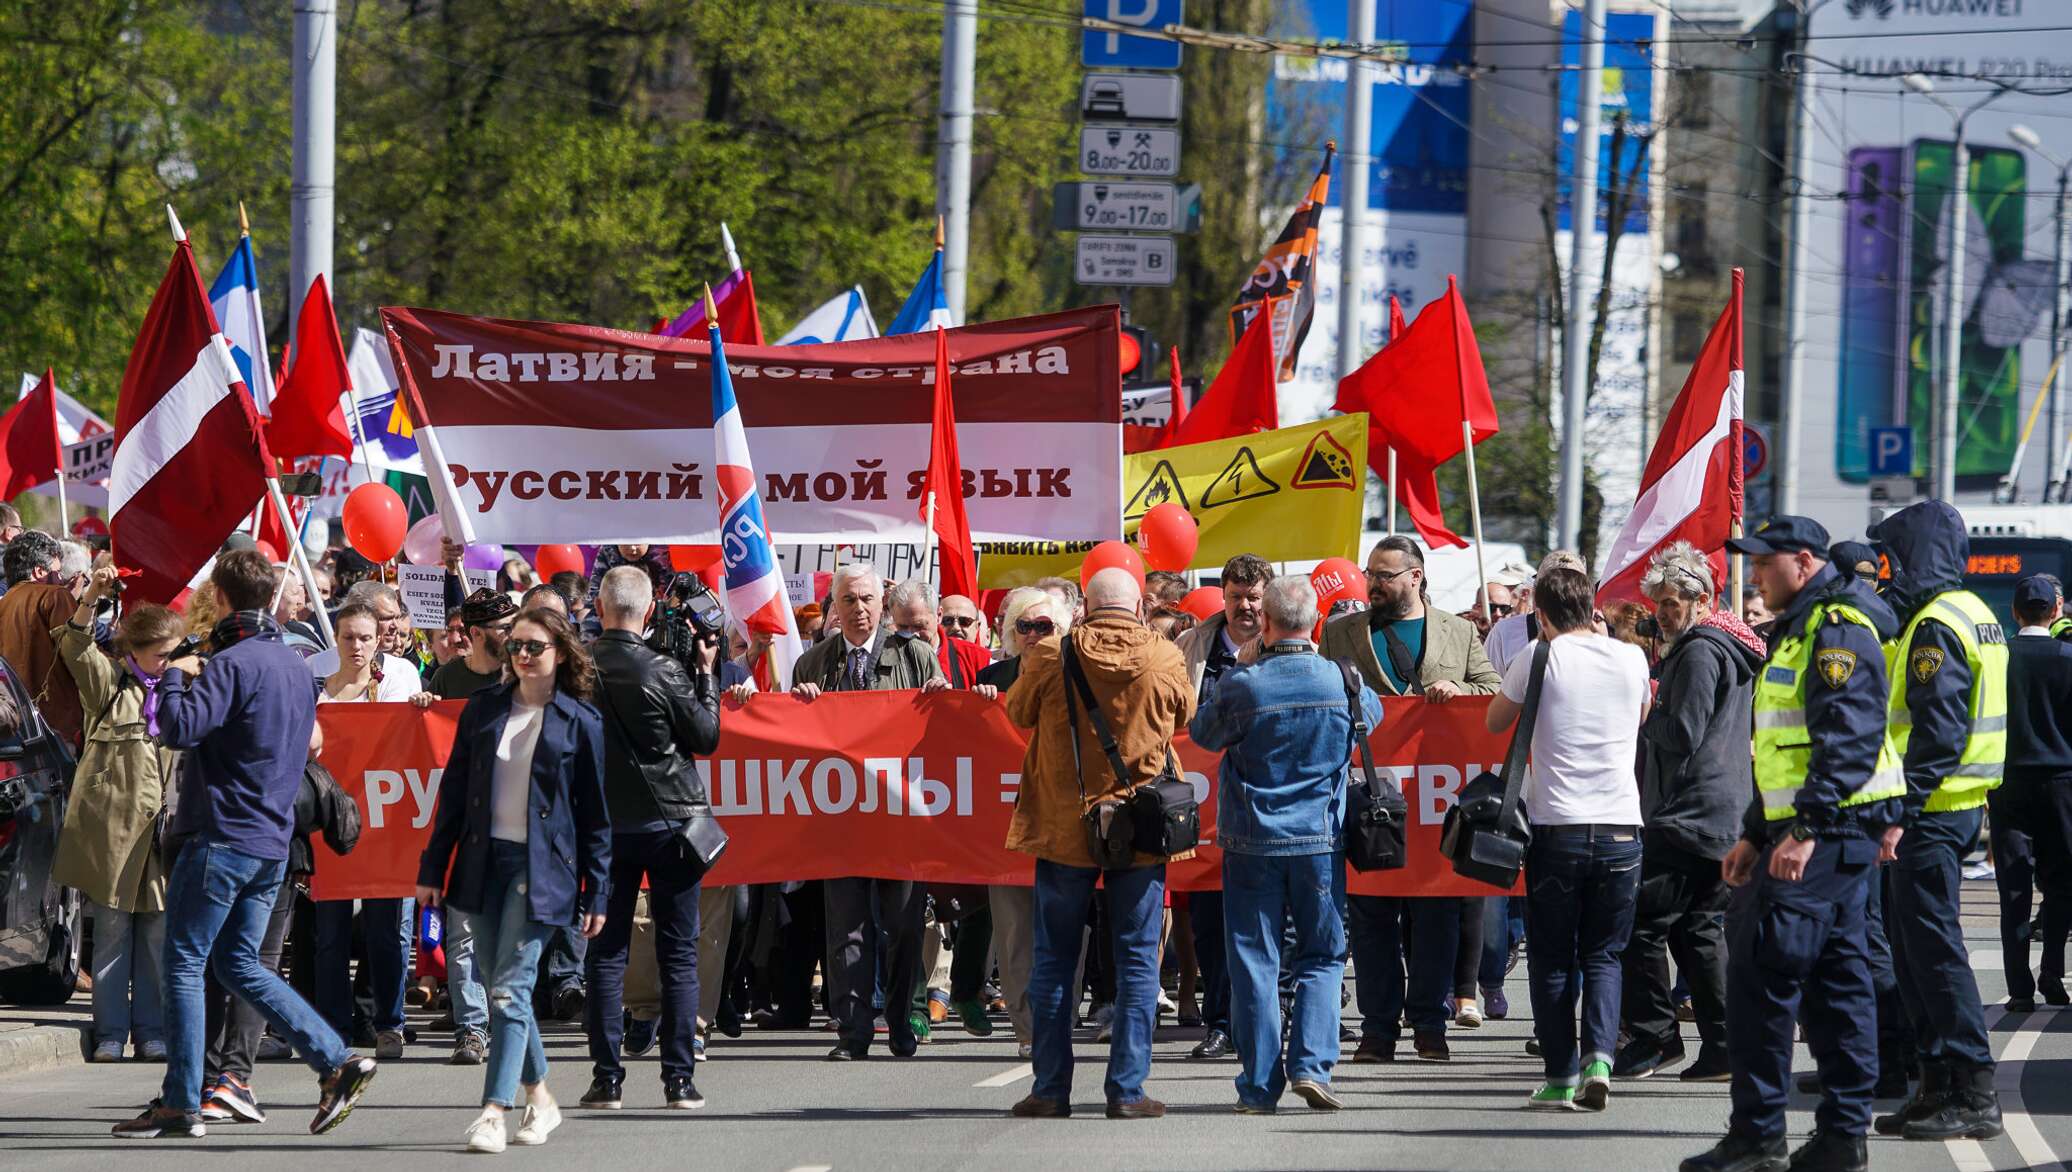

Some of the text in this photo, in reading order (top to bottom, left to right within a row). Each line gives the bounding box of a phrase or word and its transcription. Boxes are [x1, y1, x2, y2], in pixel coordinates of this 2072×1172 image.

[1147, 253, 1163, 269] B
[431, 344, 656, 383] Латвия
[729, 364, 834, 380] моя
[851, 345, 1069, 386] страна
[72, 438, 113, 467] ПР
[1877, 432, 1902, 469] P
[448, 463, 703, 513] Русский
[765, 459, 888, 502] мой
[907, 467, 1072, 500] язык
[364, 768, 444, 829] РУ
[695, 757, 973, 816] ШКОЛЫ
